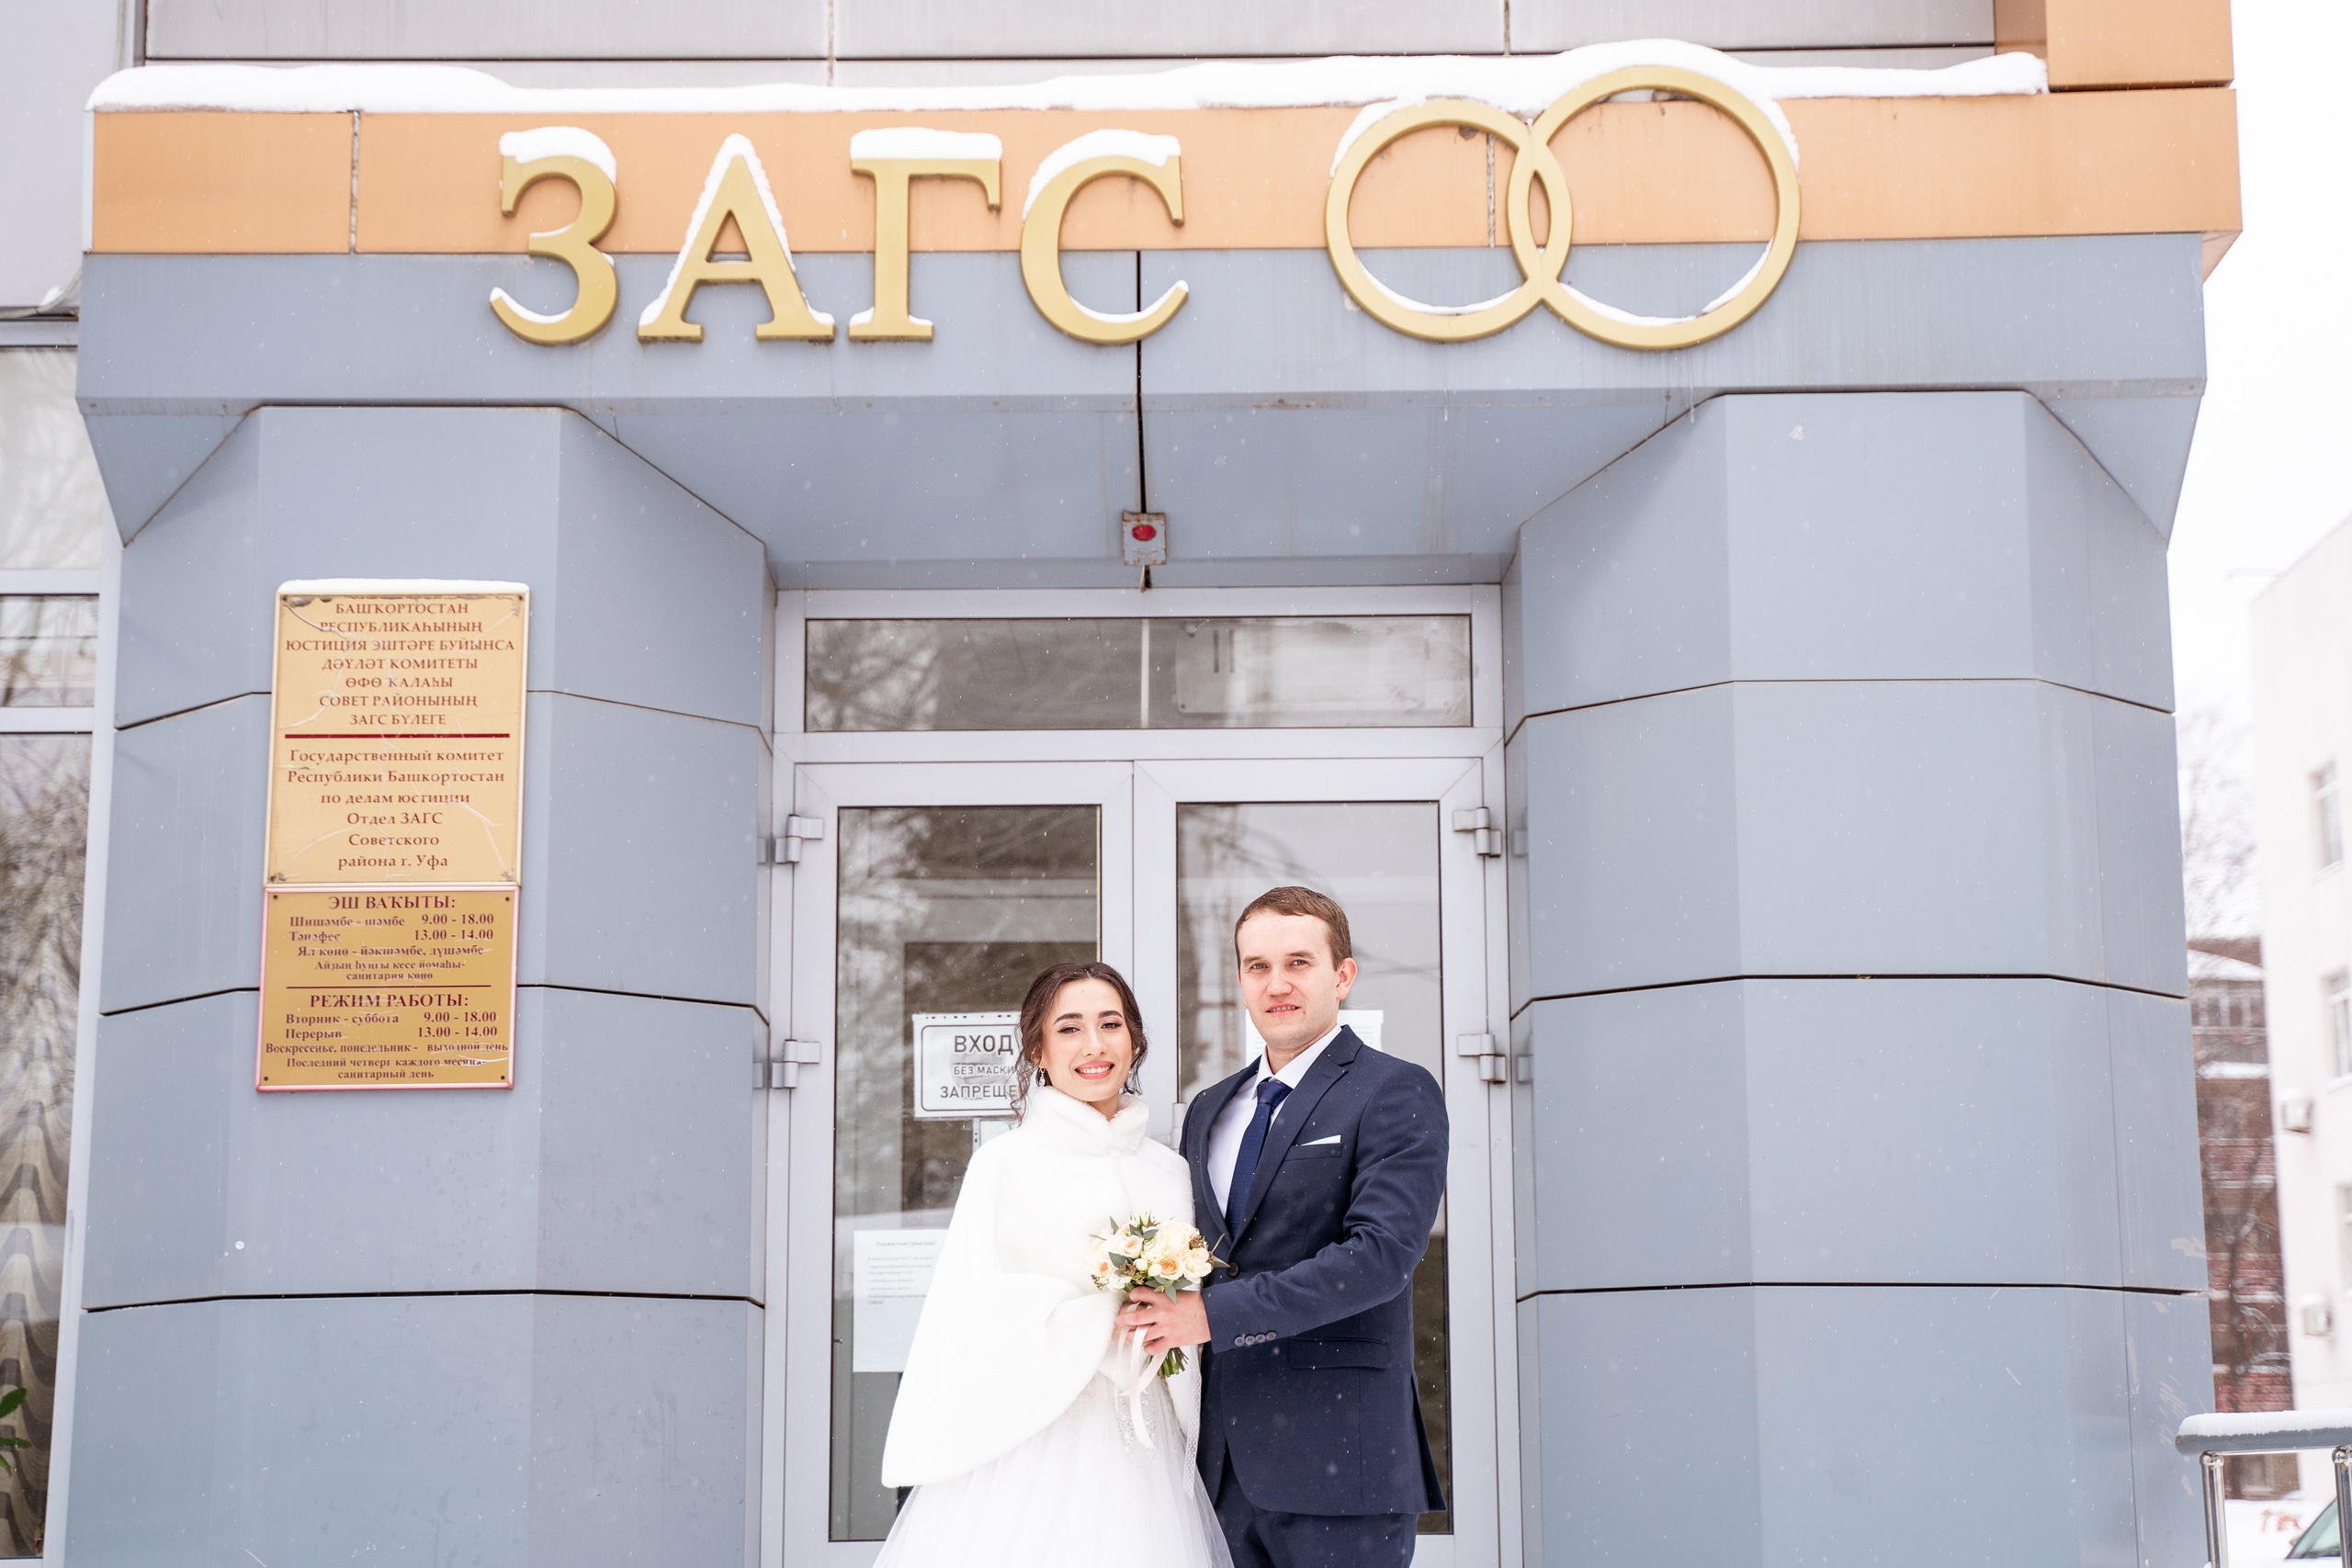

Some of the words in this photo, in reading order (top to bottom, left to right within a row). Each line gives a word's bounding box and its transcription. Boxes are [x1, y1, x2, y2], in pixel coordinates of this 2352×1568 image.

[491, 127, 1188, 345] ЗАГС
[286, 639, 368, 652] ЮСТИЦИЯ
[439, 637, 514, 651] БУЙЫНСА
[390, 658, 478, 670] КОМИТЕТЫ
[345, 677, 382, 688] ӨФӨ
[319, 695, 369, 707] СОВЕТ
[349, 714, 388, 726] ЗАГС
[290, 749, 432, 766] Государственный
[436, 752, 504, 761] комитет
[288, 770, 382, 787] Республики
[388, 770, 504, 786] Башкортостан
[321, 795, 342, 804] по
[345, 795, 393, 805] делам
[398, 795, 469, 804] юстиции
[346, 812, 396, 826] Отдел
[400, 812, 443, 825] ЗАГС
[348, 833, 440, 846] Советского
[338, 855, 396, 871] района
[401, 858, 412, 867] г.
[416, 854, 448, 871] Уфа
[328, 896, 359, 909] ЭШ
[421, 913, 448, 925] 9.00
[461, 913, 494, 925] 18.00
[414, 929, 447, 941] 13.00
[461, 929, 493, 940] 14.00
[297, 945, 315, 956] Ял
[345, 973, 404, 982] санитария
[310, 994, 380, 1008] РЕЖИМ
[387, 993, 469, 1008] РАБОТЫ:
[286, 1013, 341, 1027] Вторник
[351, 1013, 400, 1026] суббота
[424, 1011, 450, 1023] 9.00
[464, 1011, 497, 1022] 18.00
[285, 1028, 343, 1042] Перерыв
[418, 1026, 451, 1038] 13.00
[465, 1026, 498, 1037] 14.00
[266, 1043, 337, 1056] Воскресенье,
[340, 1044, 412, 1054] понедельник
[426, 1041, 481, 1052] выходной
[483, 1043, 508, 1052] день
[955, 1035, 1013, 1055] ВХОД
[287, 1057, 346, 1067] Последний
[349, 1059, 391, 1069] четверг
[337, 1069, 406, 1081] санитарный
[955, 1066, 974, 1075] БЕЗ
[978, 1066, 1014, 1074] МАСКИ
[941, 1085, 1017, 1099] ЗАПРЕЩЕ
